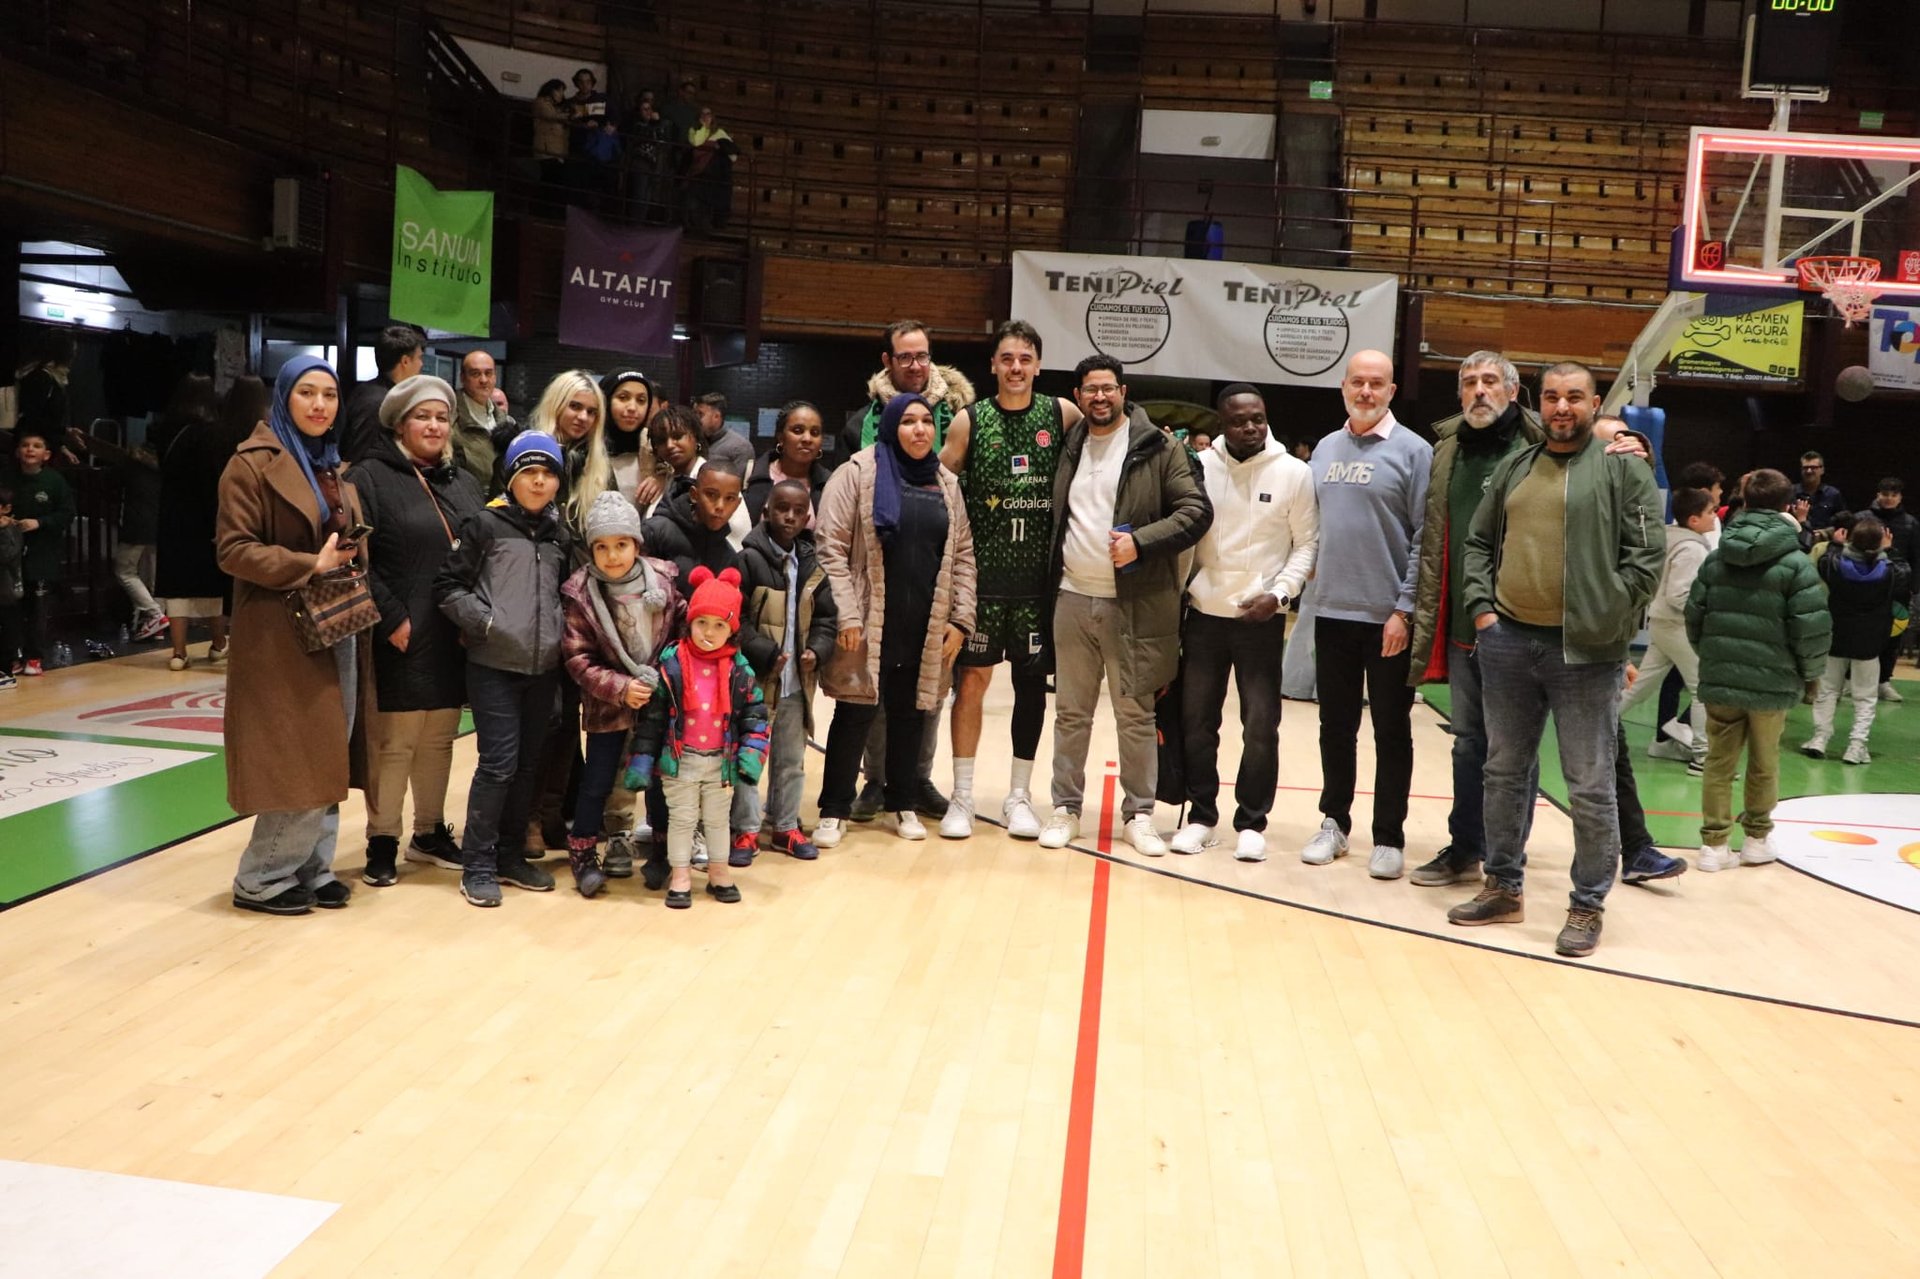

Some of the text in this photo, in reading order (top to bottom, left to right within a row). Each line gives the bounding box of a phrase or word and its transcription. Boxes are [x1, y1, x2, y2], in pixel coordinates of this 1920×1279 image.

[401, 221, 481, 266] SANUM
[570, 266, 673, 298] ALTAFIT
[600, 296, 645, 308] GYM CLUB
[1736, 312, 1789, 325] RA-MEN
[1736, 324, 1789, 336] KAGURA
[1323, 461, 1376, 484] AM76
[1011, 518, 1025, 542] 11
